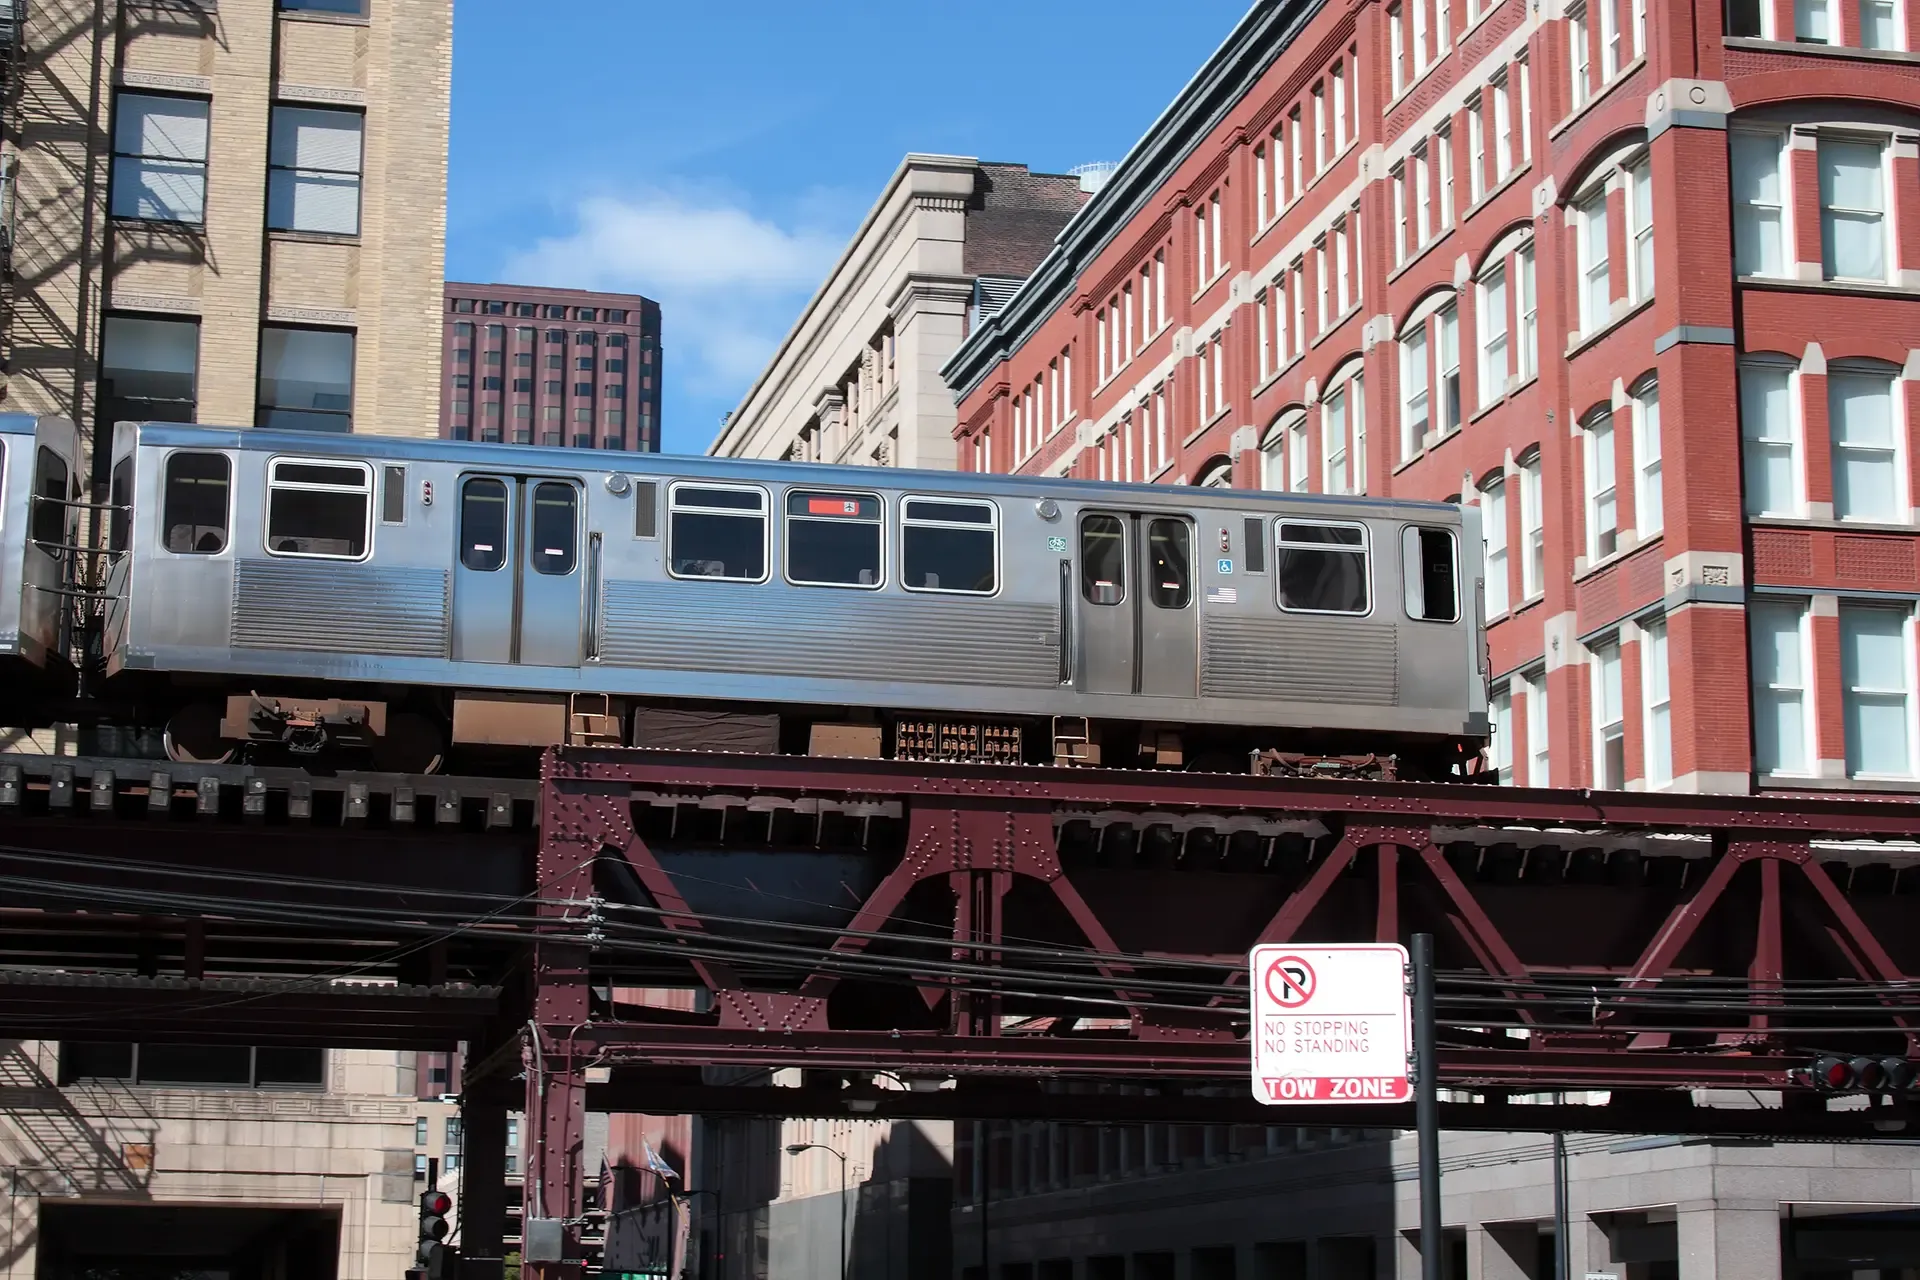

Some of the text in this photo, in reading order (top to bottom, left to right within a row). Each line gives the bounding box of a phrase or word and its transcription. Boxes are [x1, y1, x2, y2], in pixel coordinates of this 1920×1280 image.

[1264, 1021, 1369, 1036] NO STOPPING
[1264, 1039, 1370, 1053] NO STANDING
[1265, 1078, 1396, 1098] TOW ZONE
